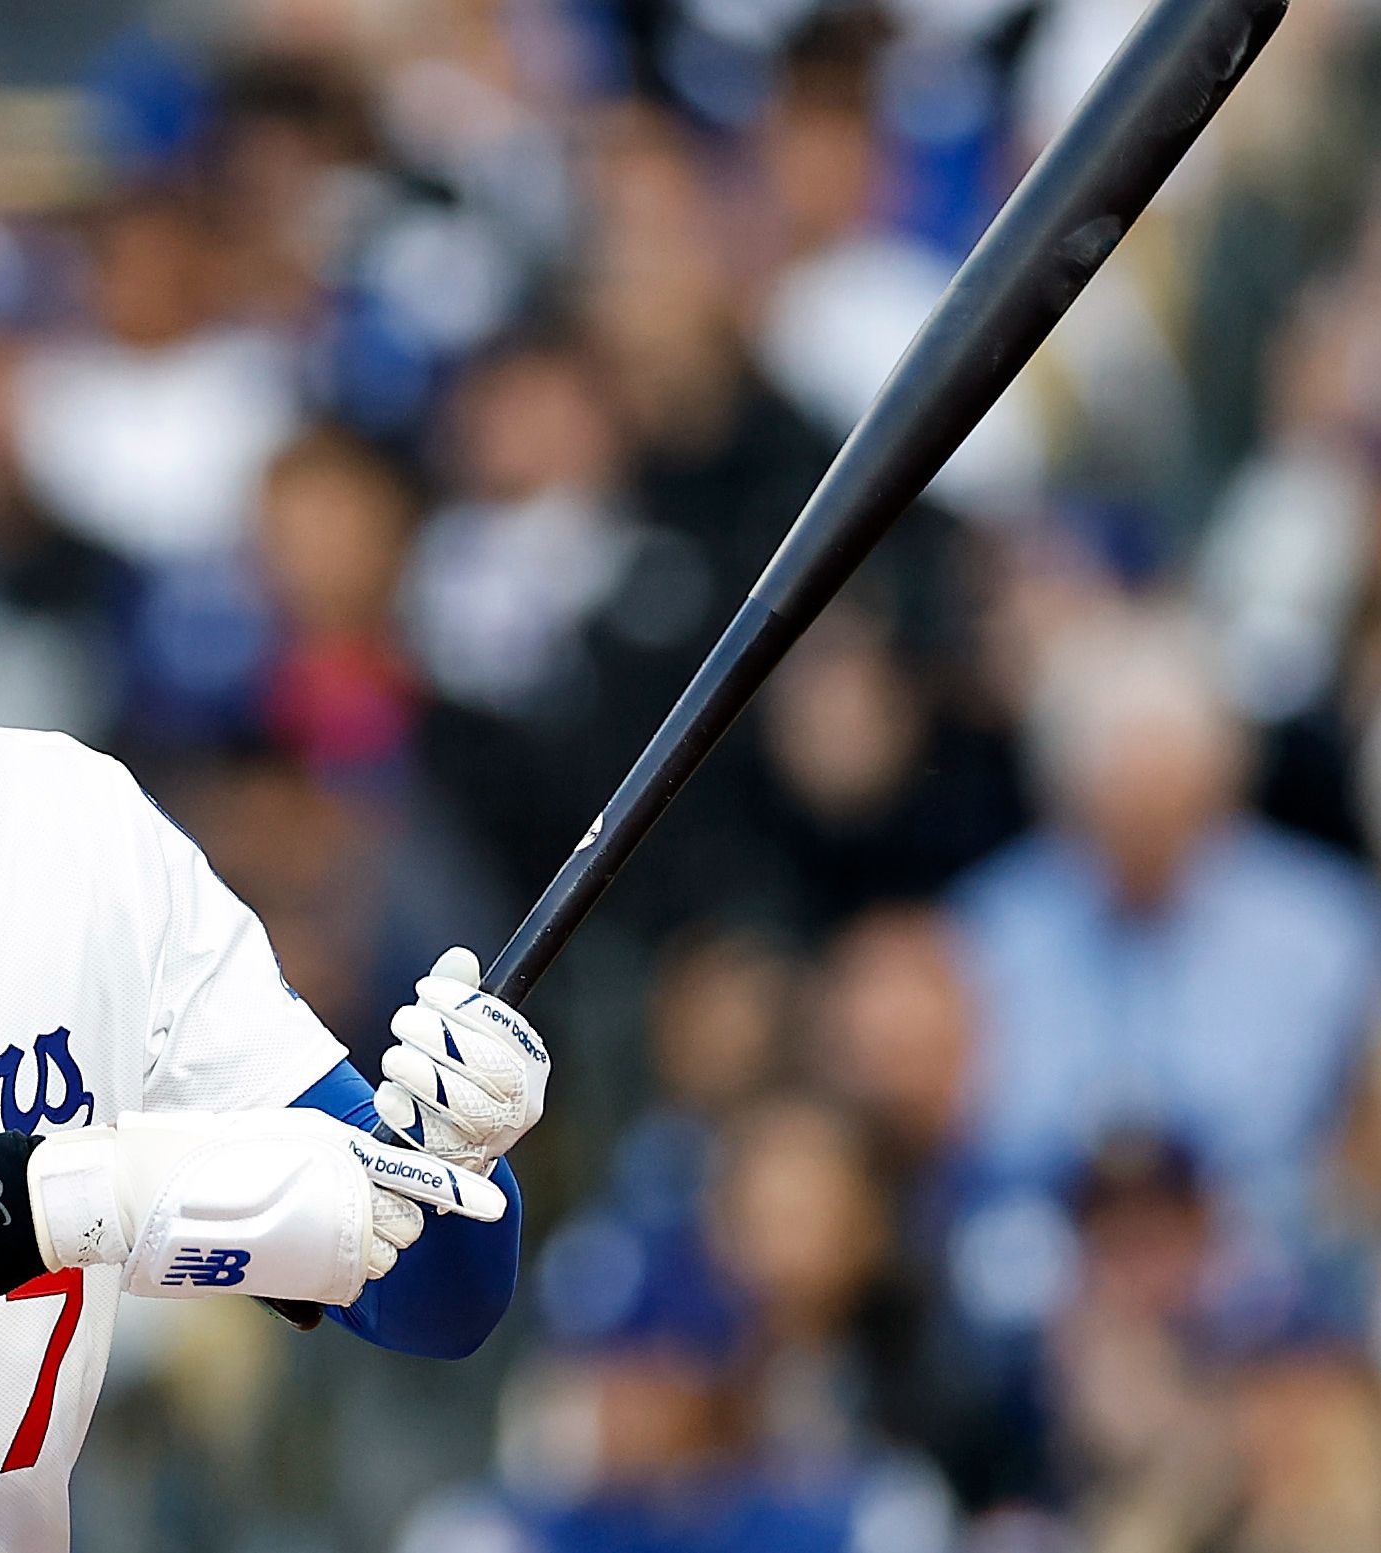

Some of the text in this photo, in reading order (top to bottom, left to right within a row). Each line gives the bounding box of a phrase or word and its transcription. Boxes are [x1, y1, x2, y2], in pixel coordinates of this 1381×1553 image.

[482, 1004, 511, 1027] new
[375, 1156, 443, 1188] balance
[160, 1248, 251, 1286] NB
